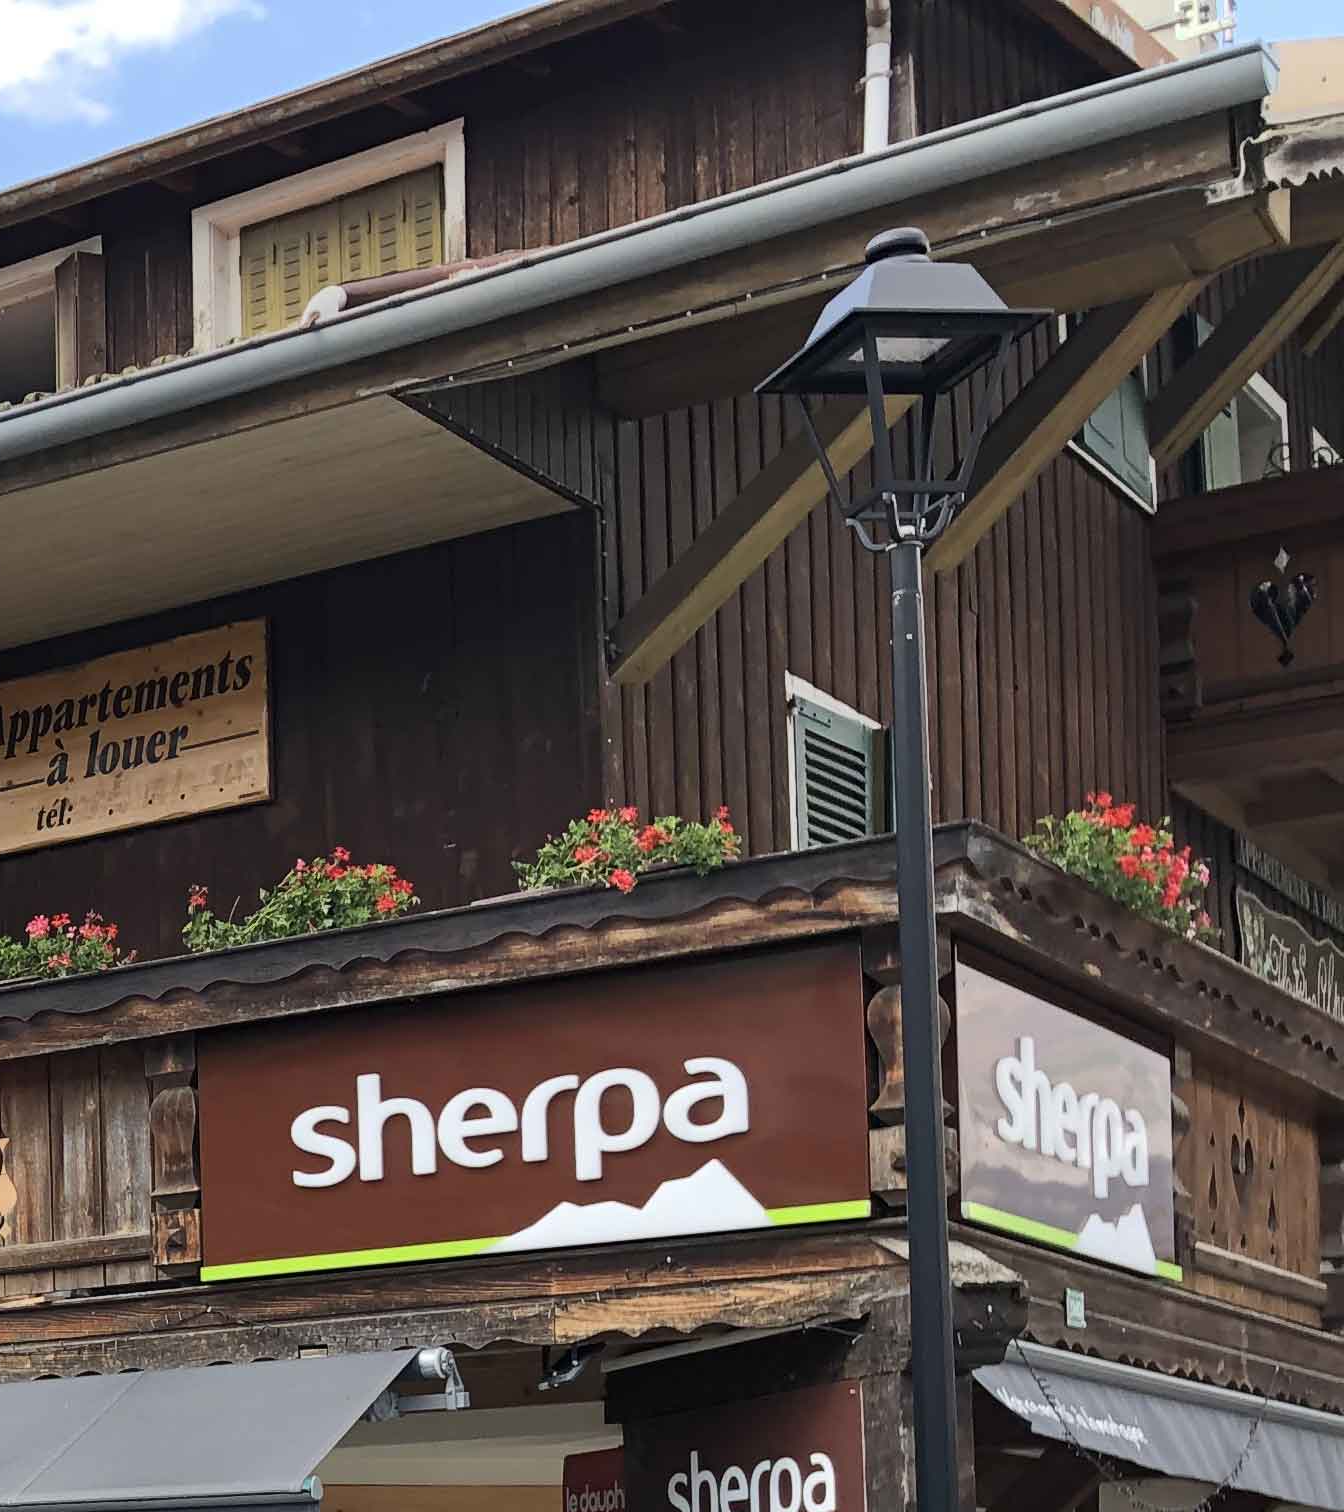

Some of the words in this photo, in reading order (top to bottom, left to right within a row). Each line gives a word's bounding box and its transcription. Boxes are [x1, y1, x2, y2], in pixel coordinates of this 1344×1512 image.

[46, 738, 70, 787] à
[83, 724, 189, 778] louer
[290, 1057, 749, 1188] sherpa
[995, 1036, 1150, 1199] sherpa
